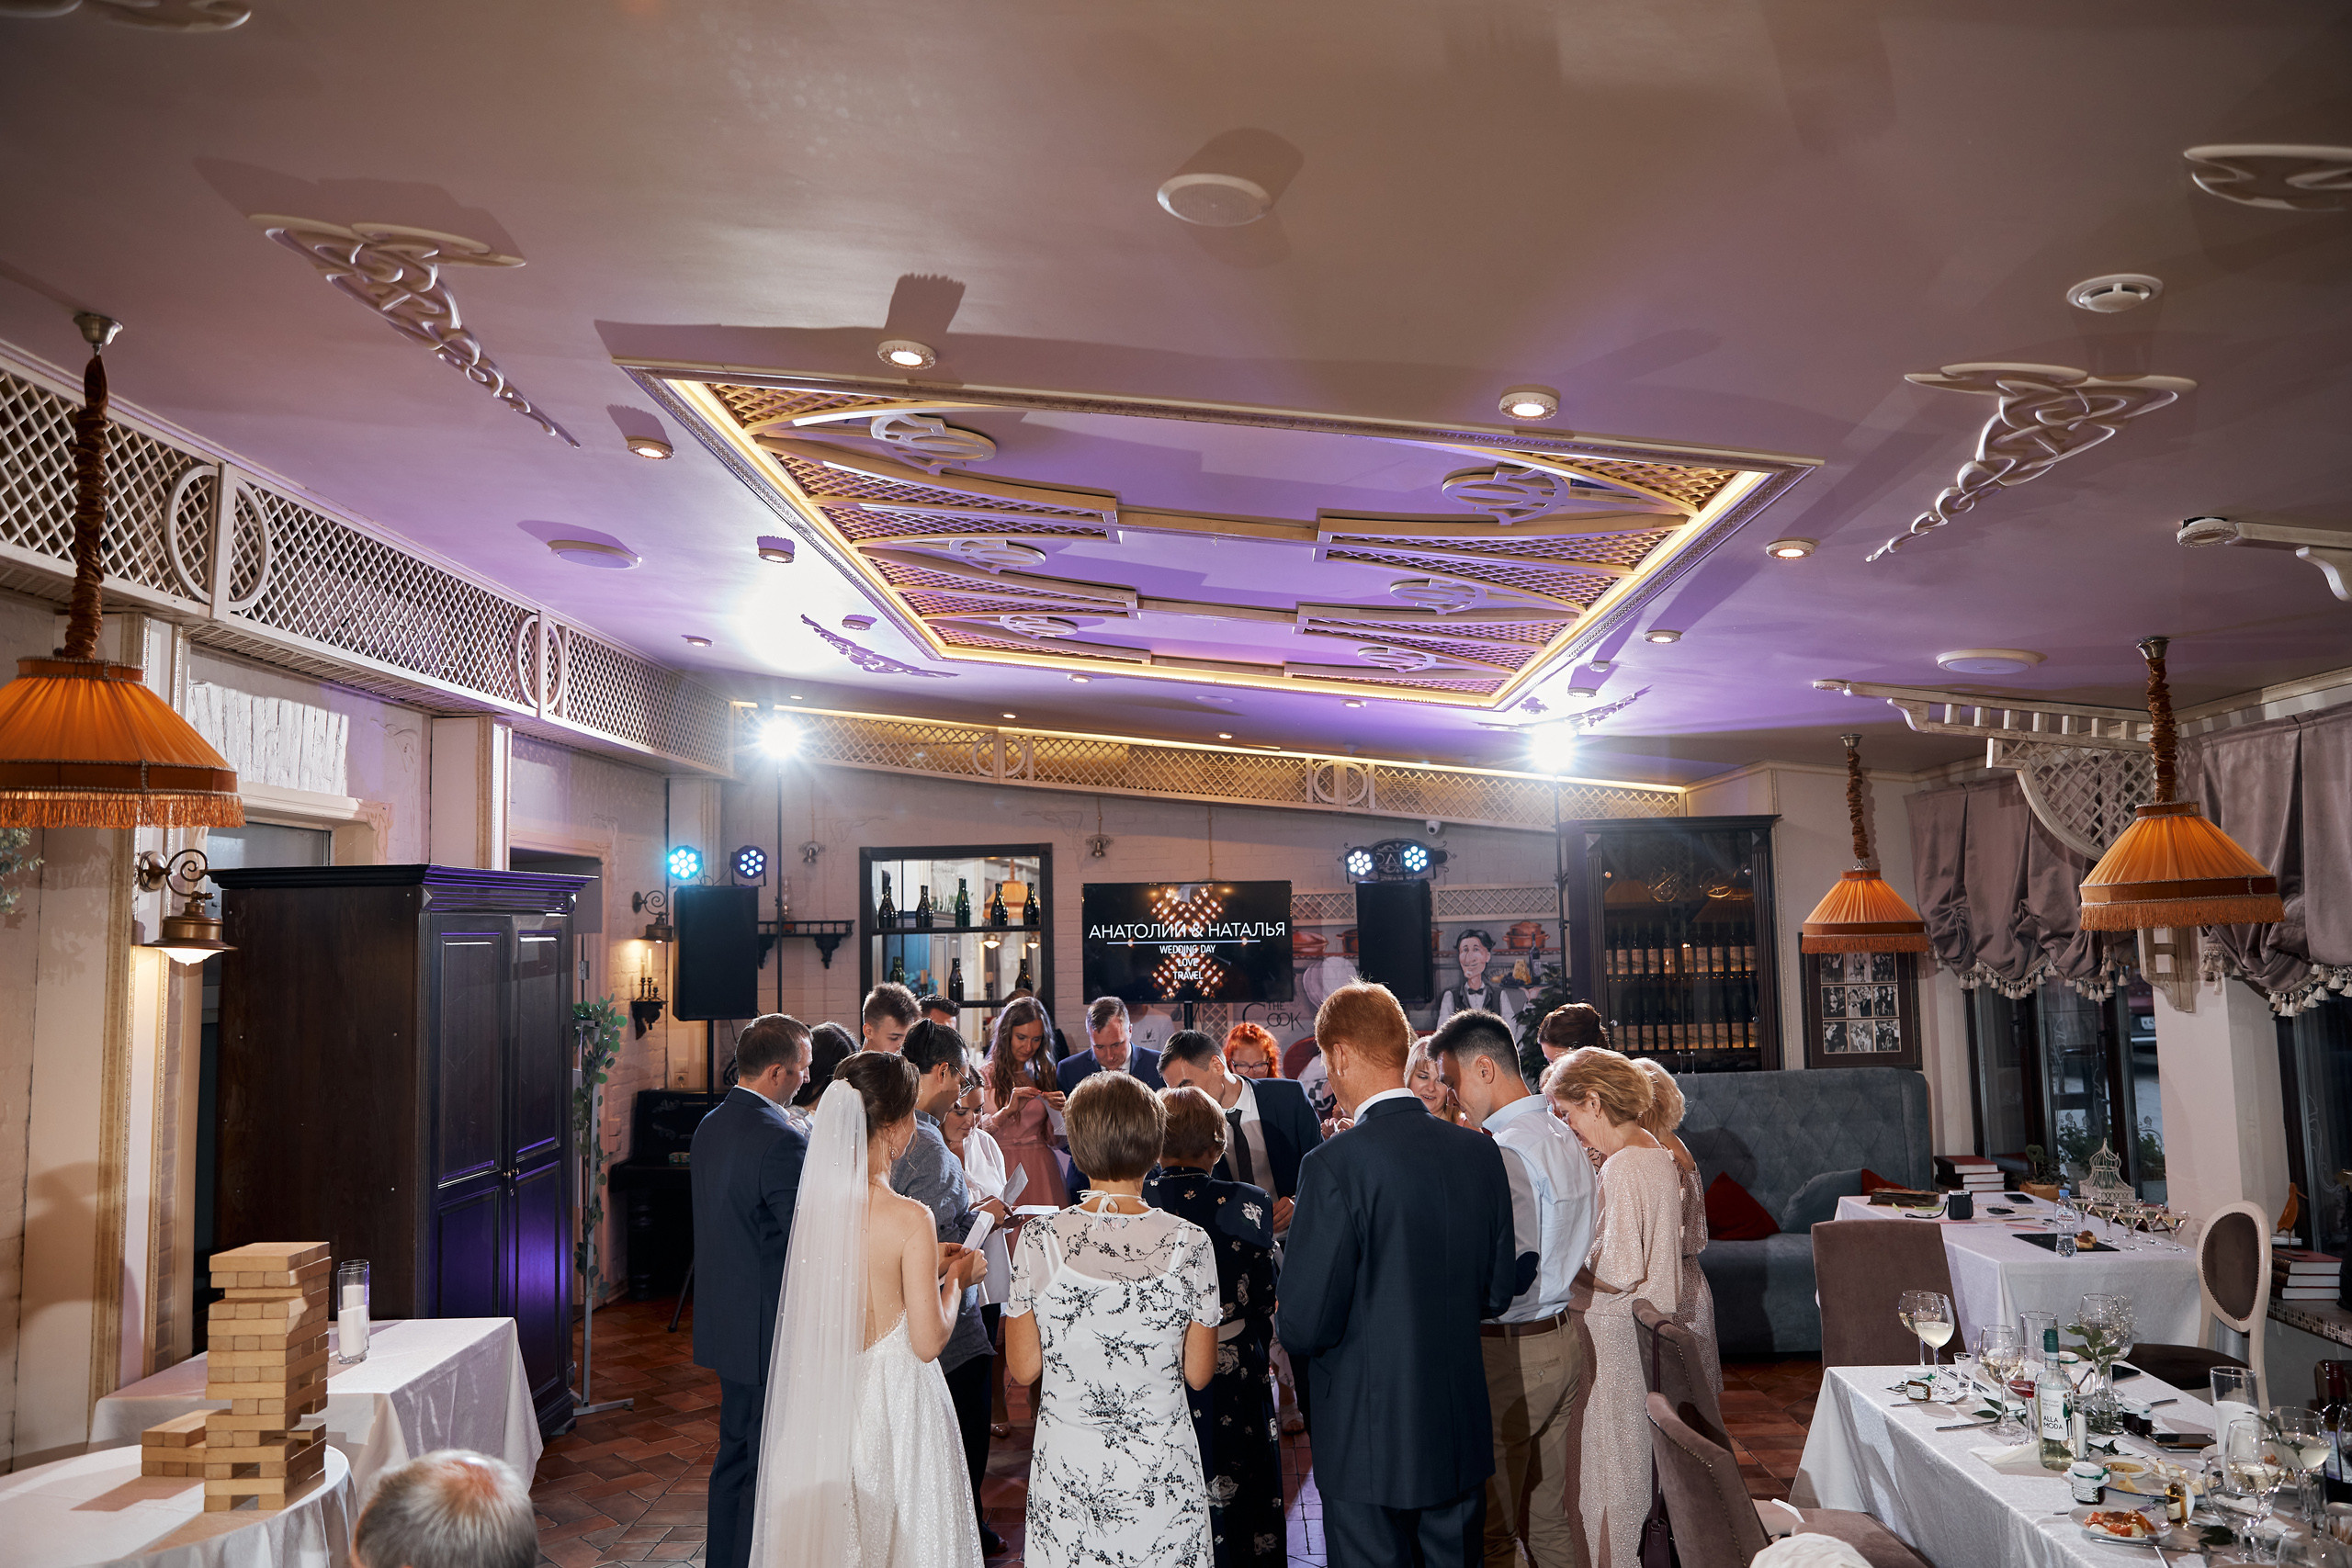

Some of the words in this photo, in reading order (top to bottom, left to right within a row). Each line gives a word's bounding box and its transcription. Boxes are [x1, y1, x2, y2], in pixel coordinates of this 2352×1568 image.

[1088, 920, 1187, 939] АНАТОЛИЙ
[1191, 922, 1204, 938] &
[1208, 921, 1285, 937] НАТАЛЬЯ
[1159, 944, 1198, 954] WEDDING
[1200, 944, 1216, 953] DAY
[1177, 958, 1198, 967] LOVE
[1172, 971, 1204, 980] TRAVEL
[2043, 1422, 2064, 1430] MODA
